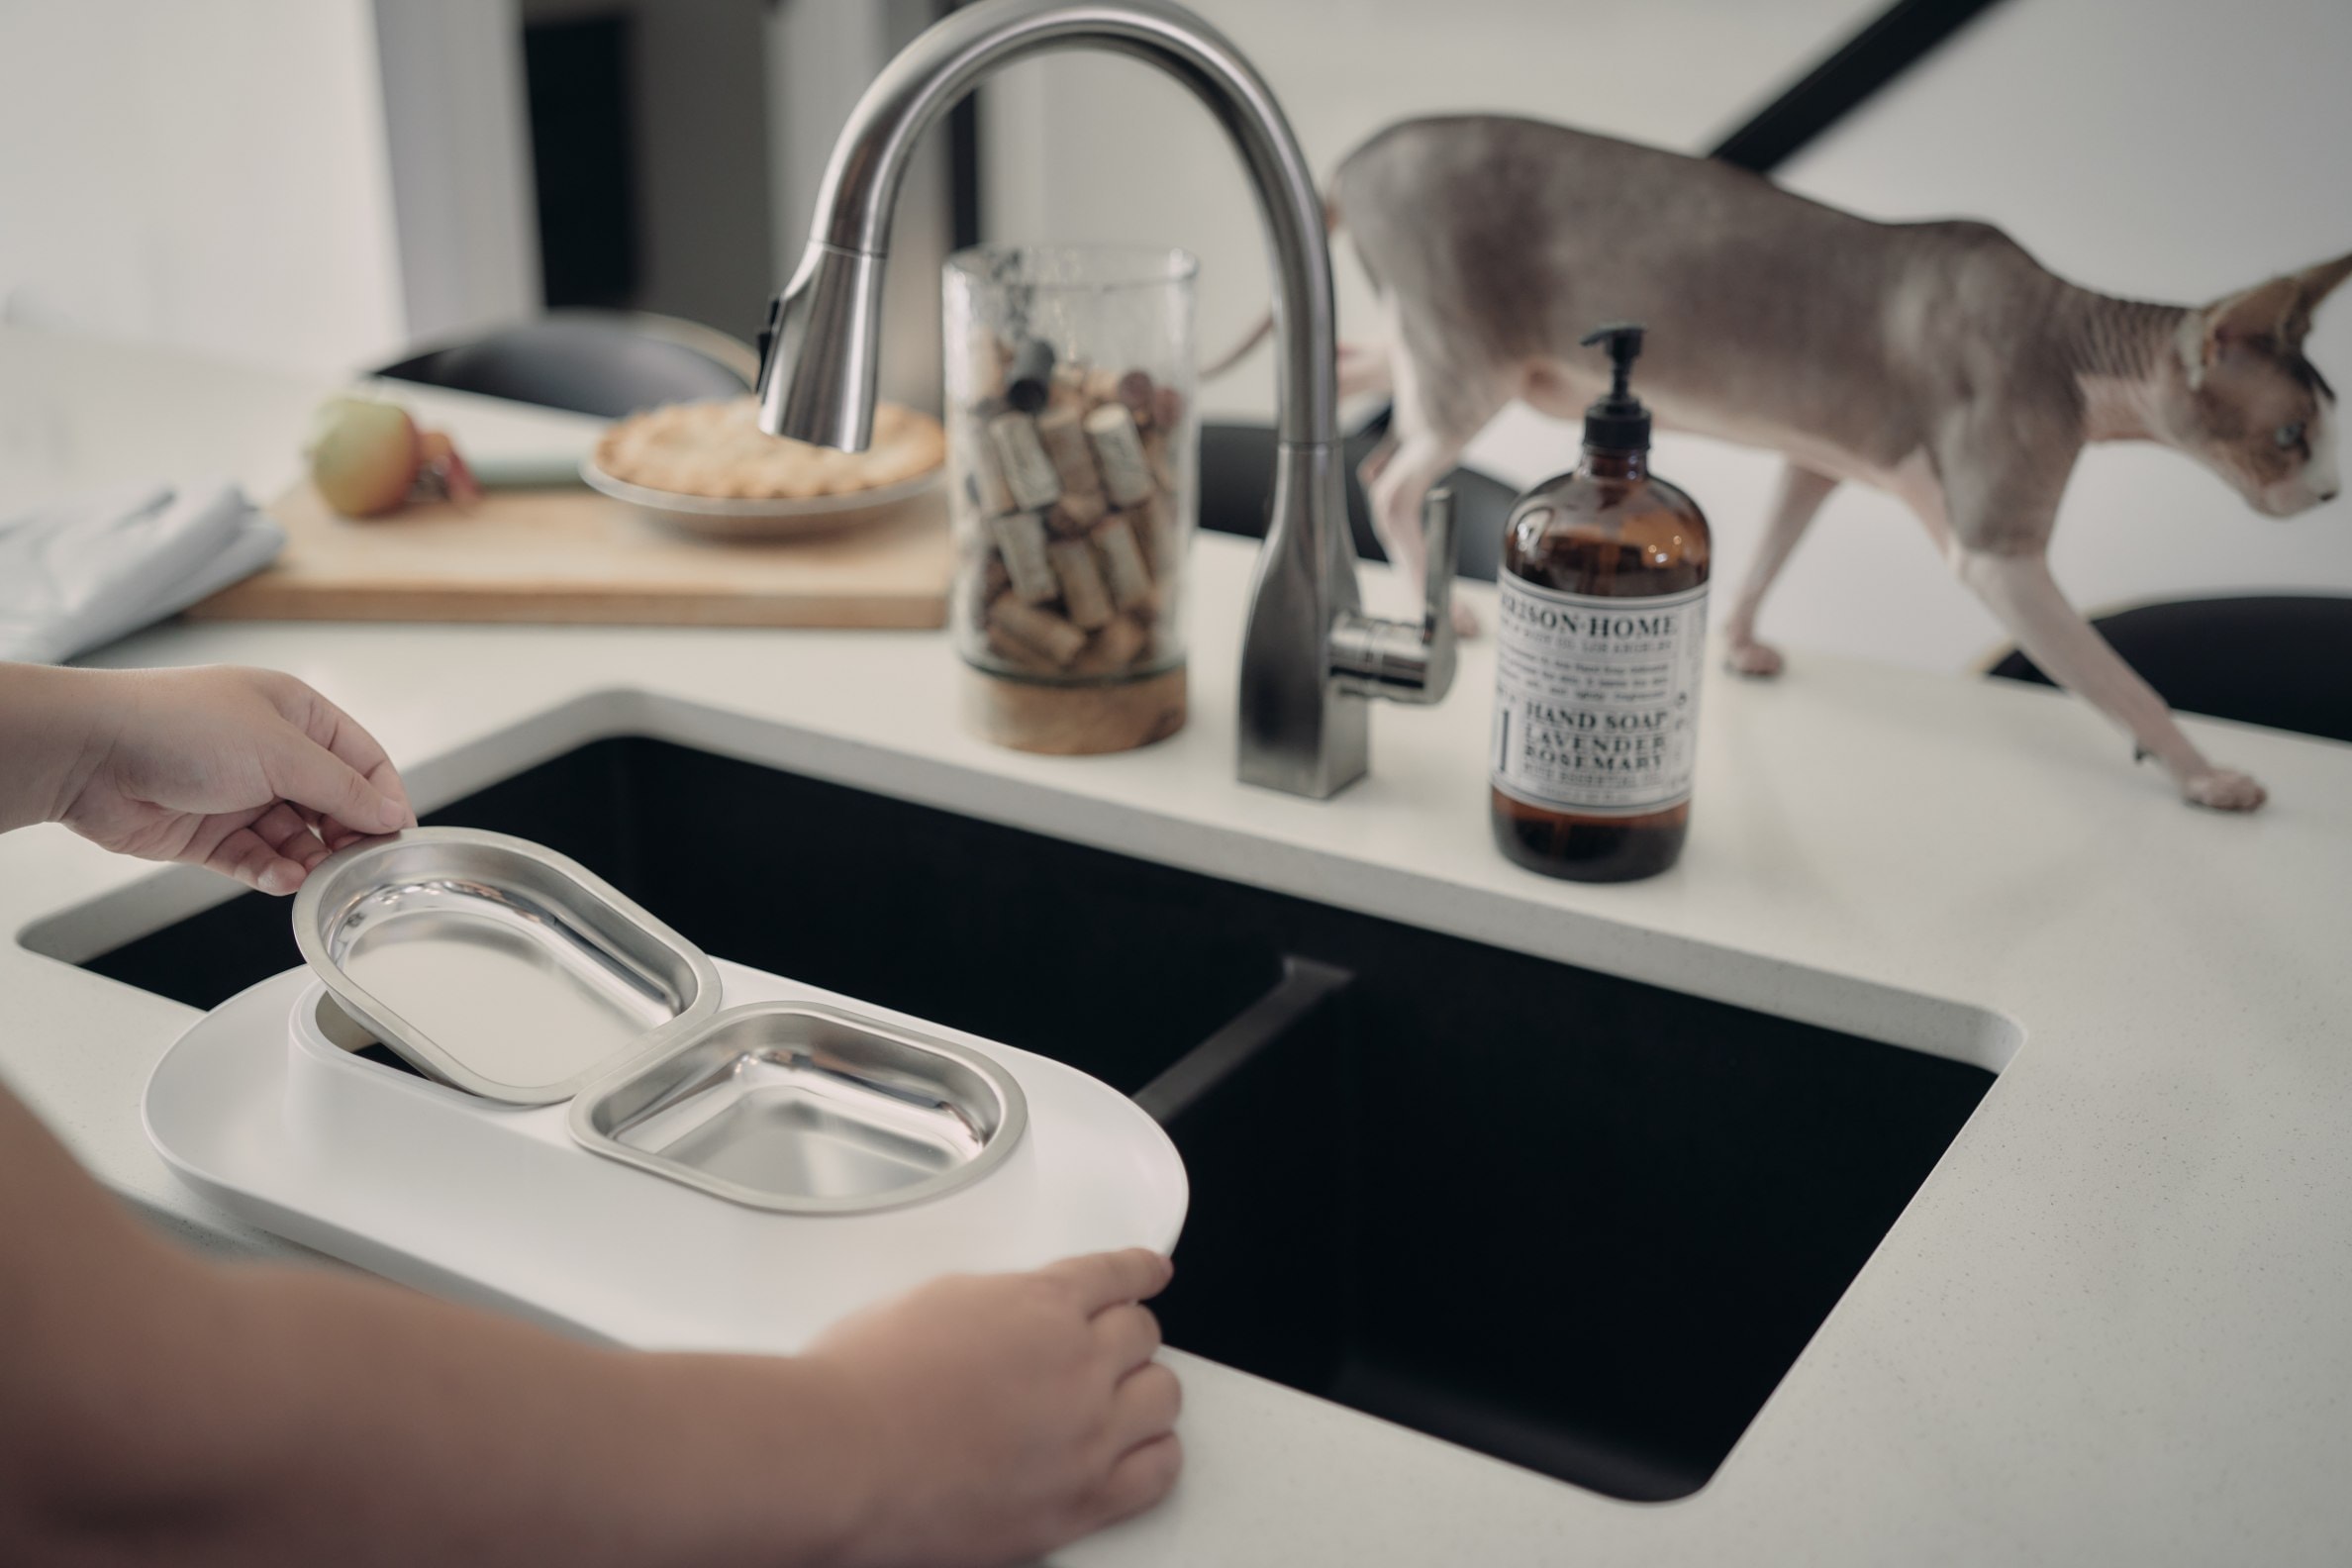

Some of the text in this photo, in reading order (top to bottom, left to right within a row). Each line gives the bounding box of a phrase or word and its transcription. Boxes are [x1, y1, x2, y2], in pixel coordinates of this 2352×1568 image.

[1589, 614, 1677, 639] HOME
[1525, 700, 1597, 731] HAND
[1604, 710, 1668, 732] SOAP
[1523, 719, 1666, 753] LAVENDER
[1522, 744, 1664, 772] ROSEMARY
